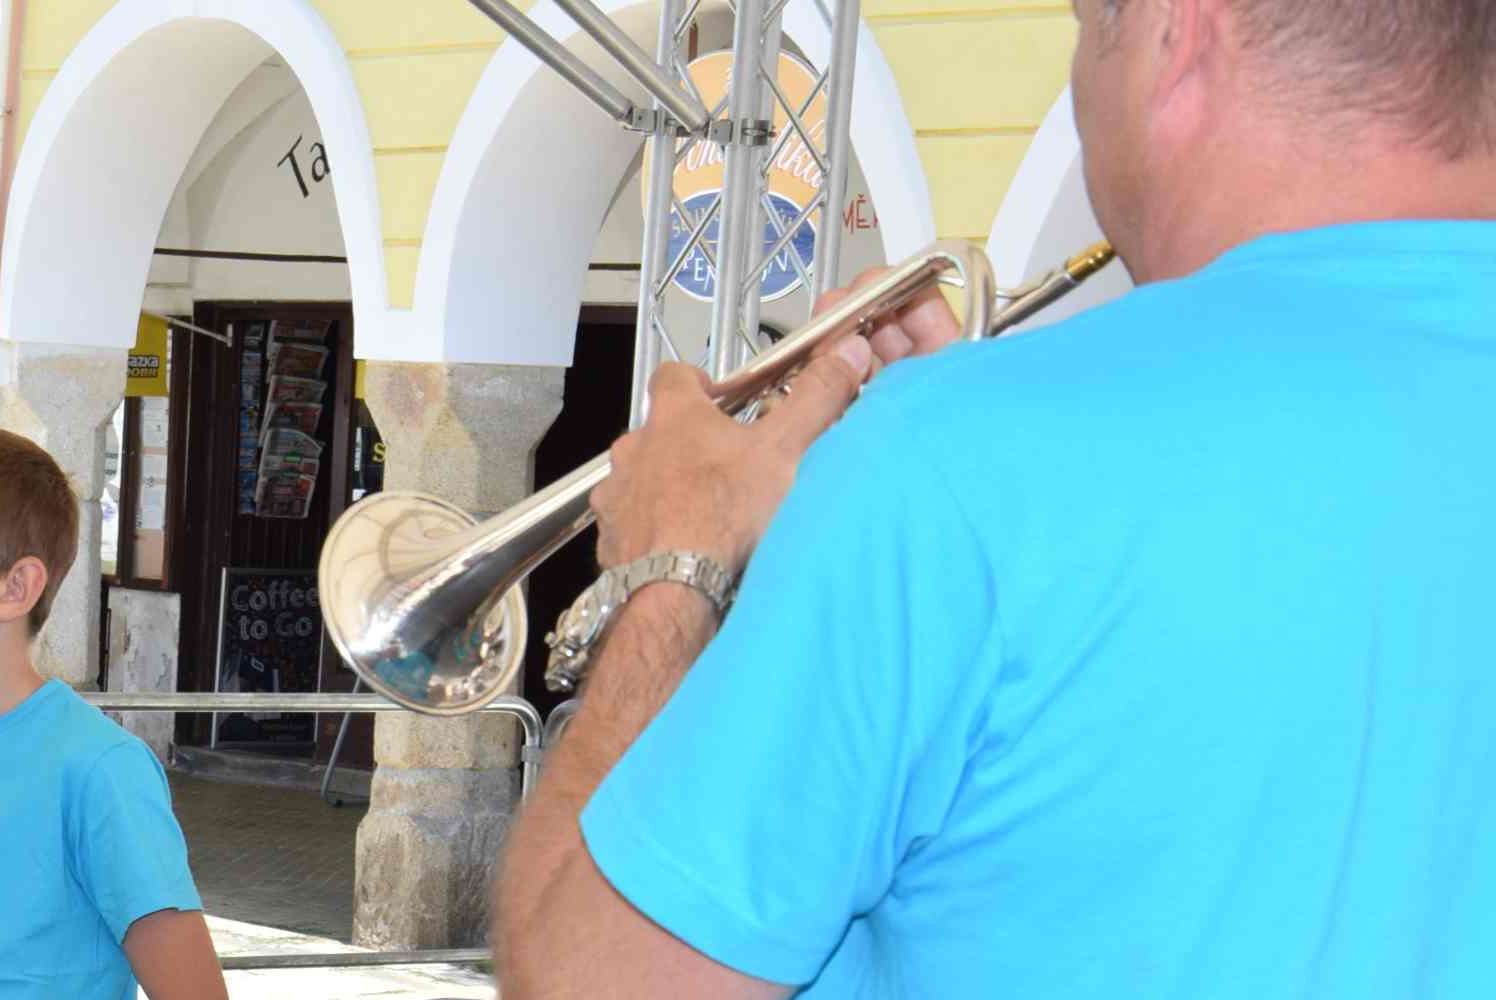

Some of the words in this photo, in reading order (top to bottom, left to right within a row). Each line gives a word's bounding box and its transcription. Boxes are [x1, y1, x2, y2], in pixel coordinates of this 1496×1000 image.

[231, 579, 319, 612] Coffee
[238, 614, 268, 640] to
[274, 611, 313, 637] Go
